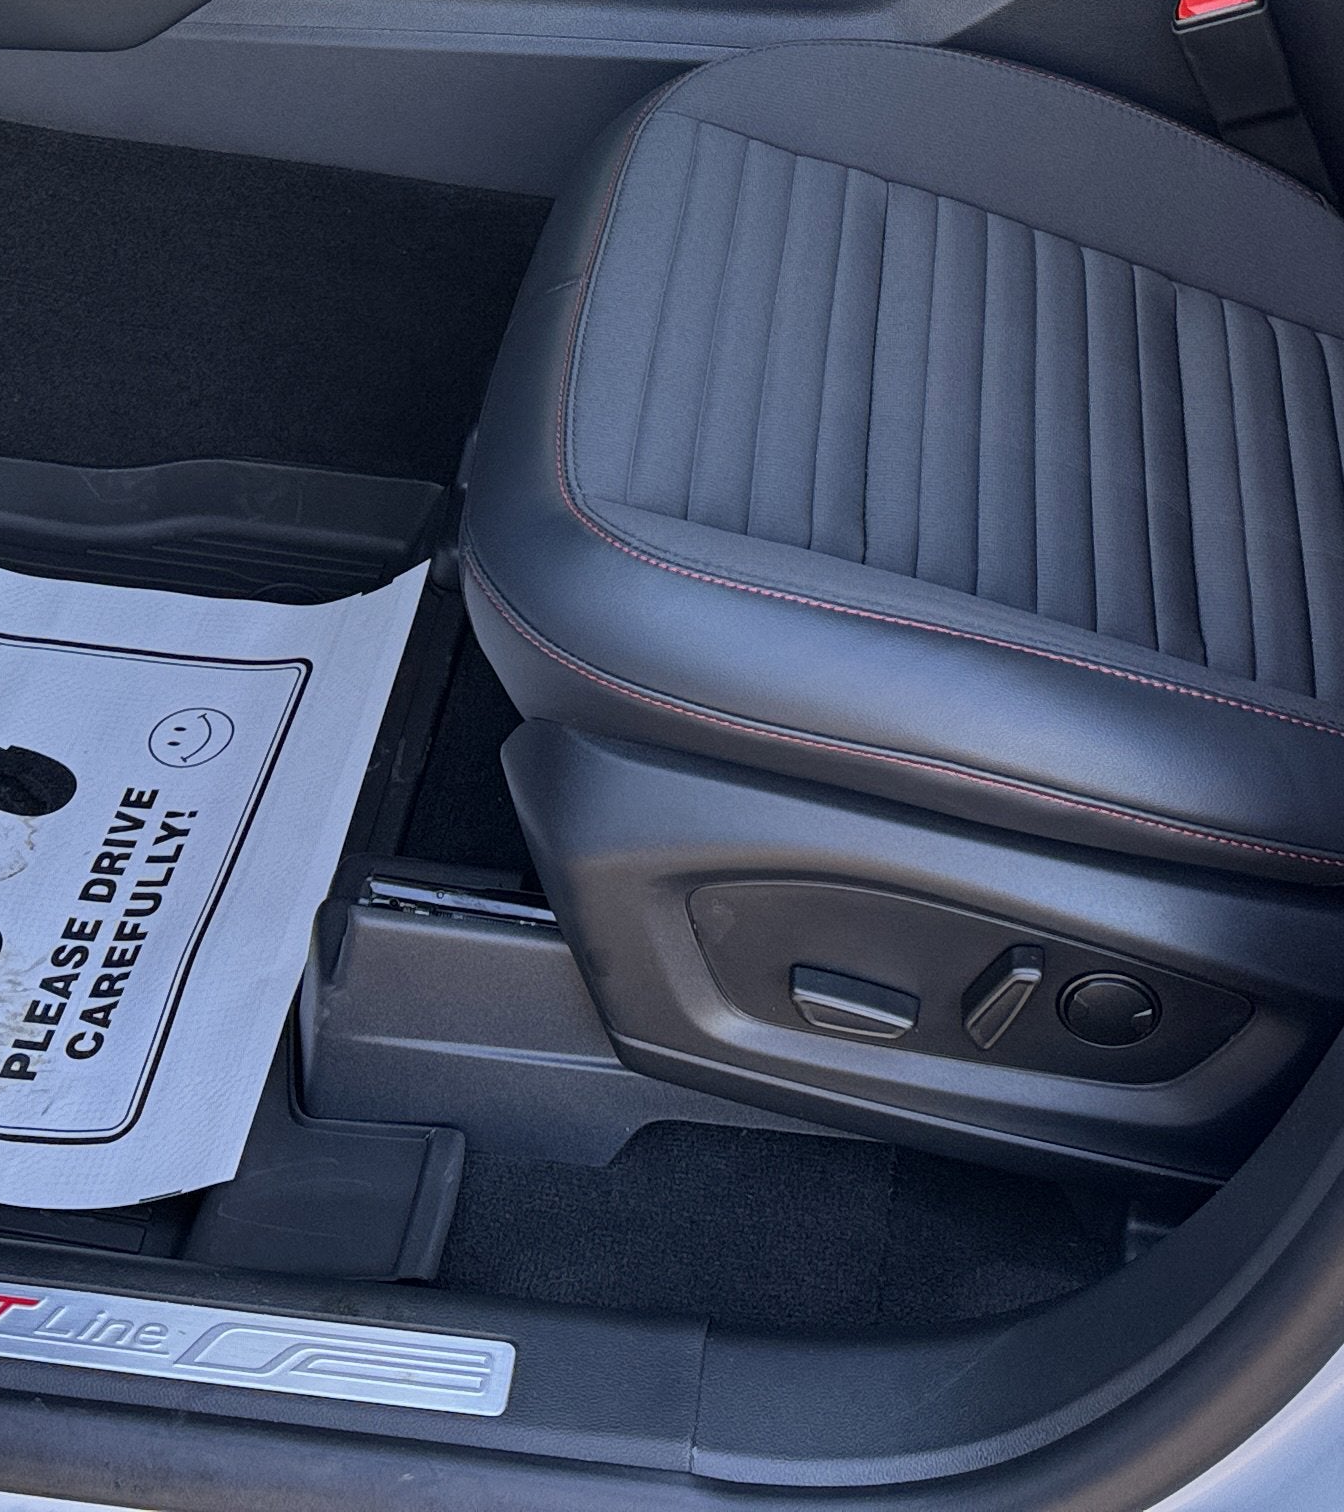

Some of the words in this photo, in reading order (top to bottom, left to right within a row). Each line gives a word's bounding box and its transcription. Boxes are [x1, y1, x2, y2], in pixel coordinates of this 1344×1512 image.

[78, 787, 159, 903] DRIVE
[65, 810, 198, 1060] CAREFULLY!
[34, 1304, 169, 1349] Line
